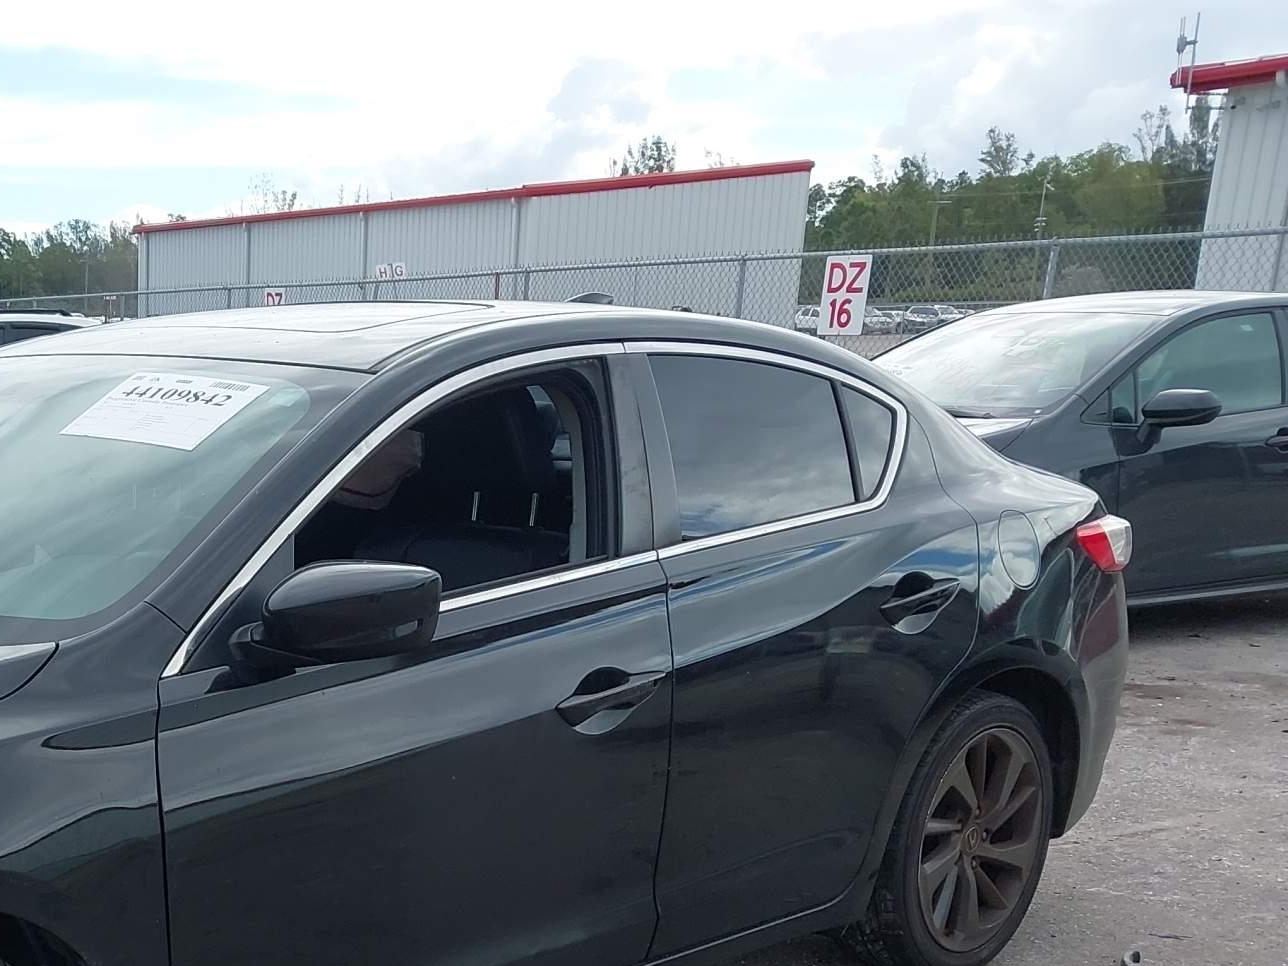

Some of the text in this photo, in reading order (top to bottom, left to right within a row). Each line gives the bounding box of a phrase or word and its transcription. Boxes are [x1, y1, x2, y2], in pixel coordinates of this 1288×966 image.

[827, 261, 867, 294] DZ
[828, 298, 853, 329] 16
[122, 385, 233, 407] 44109842
